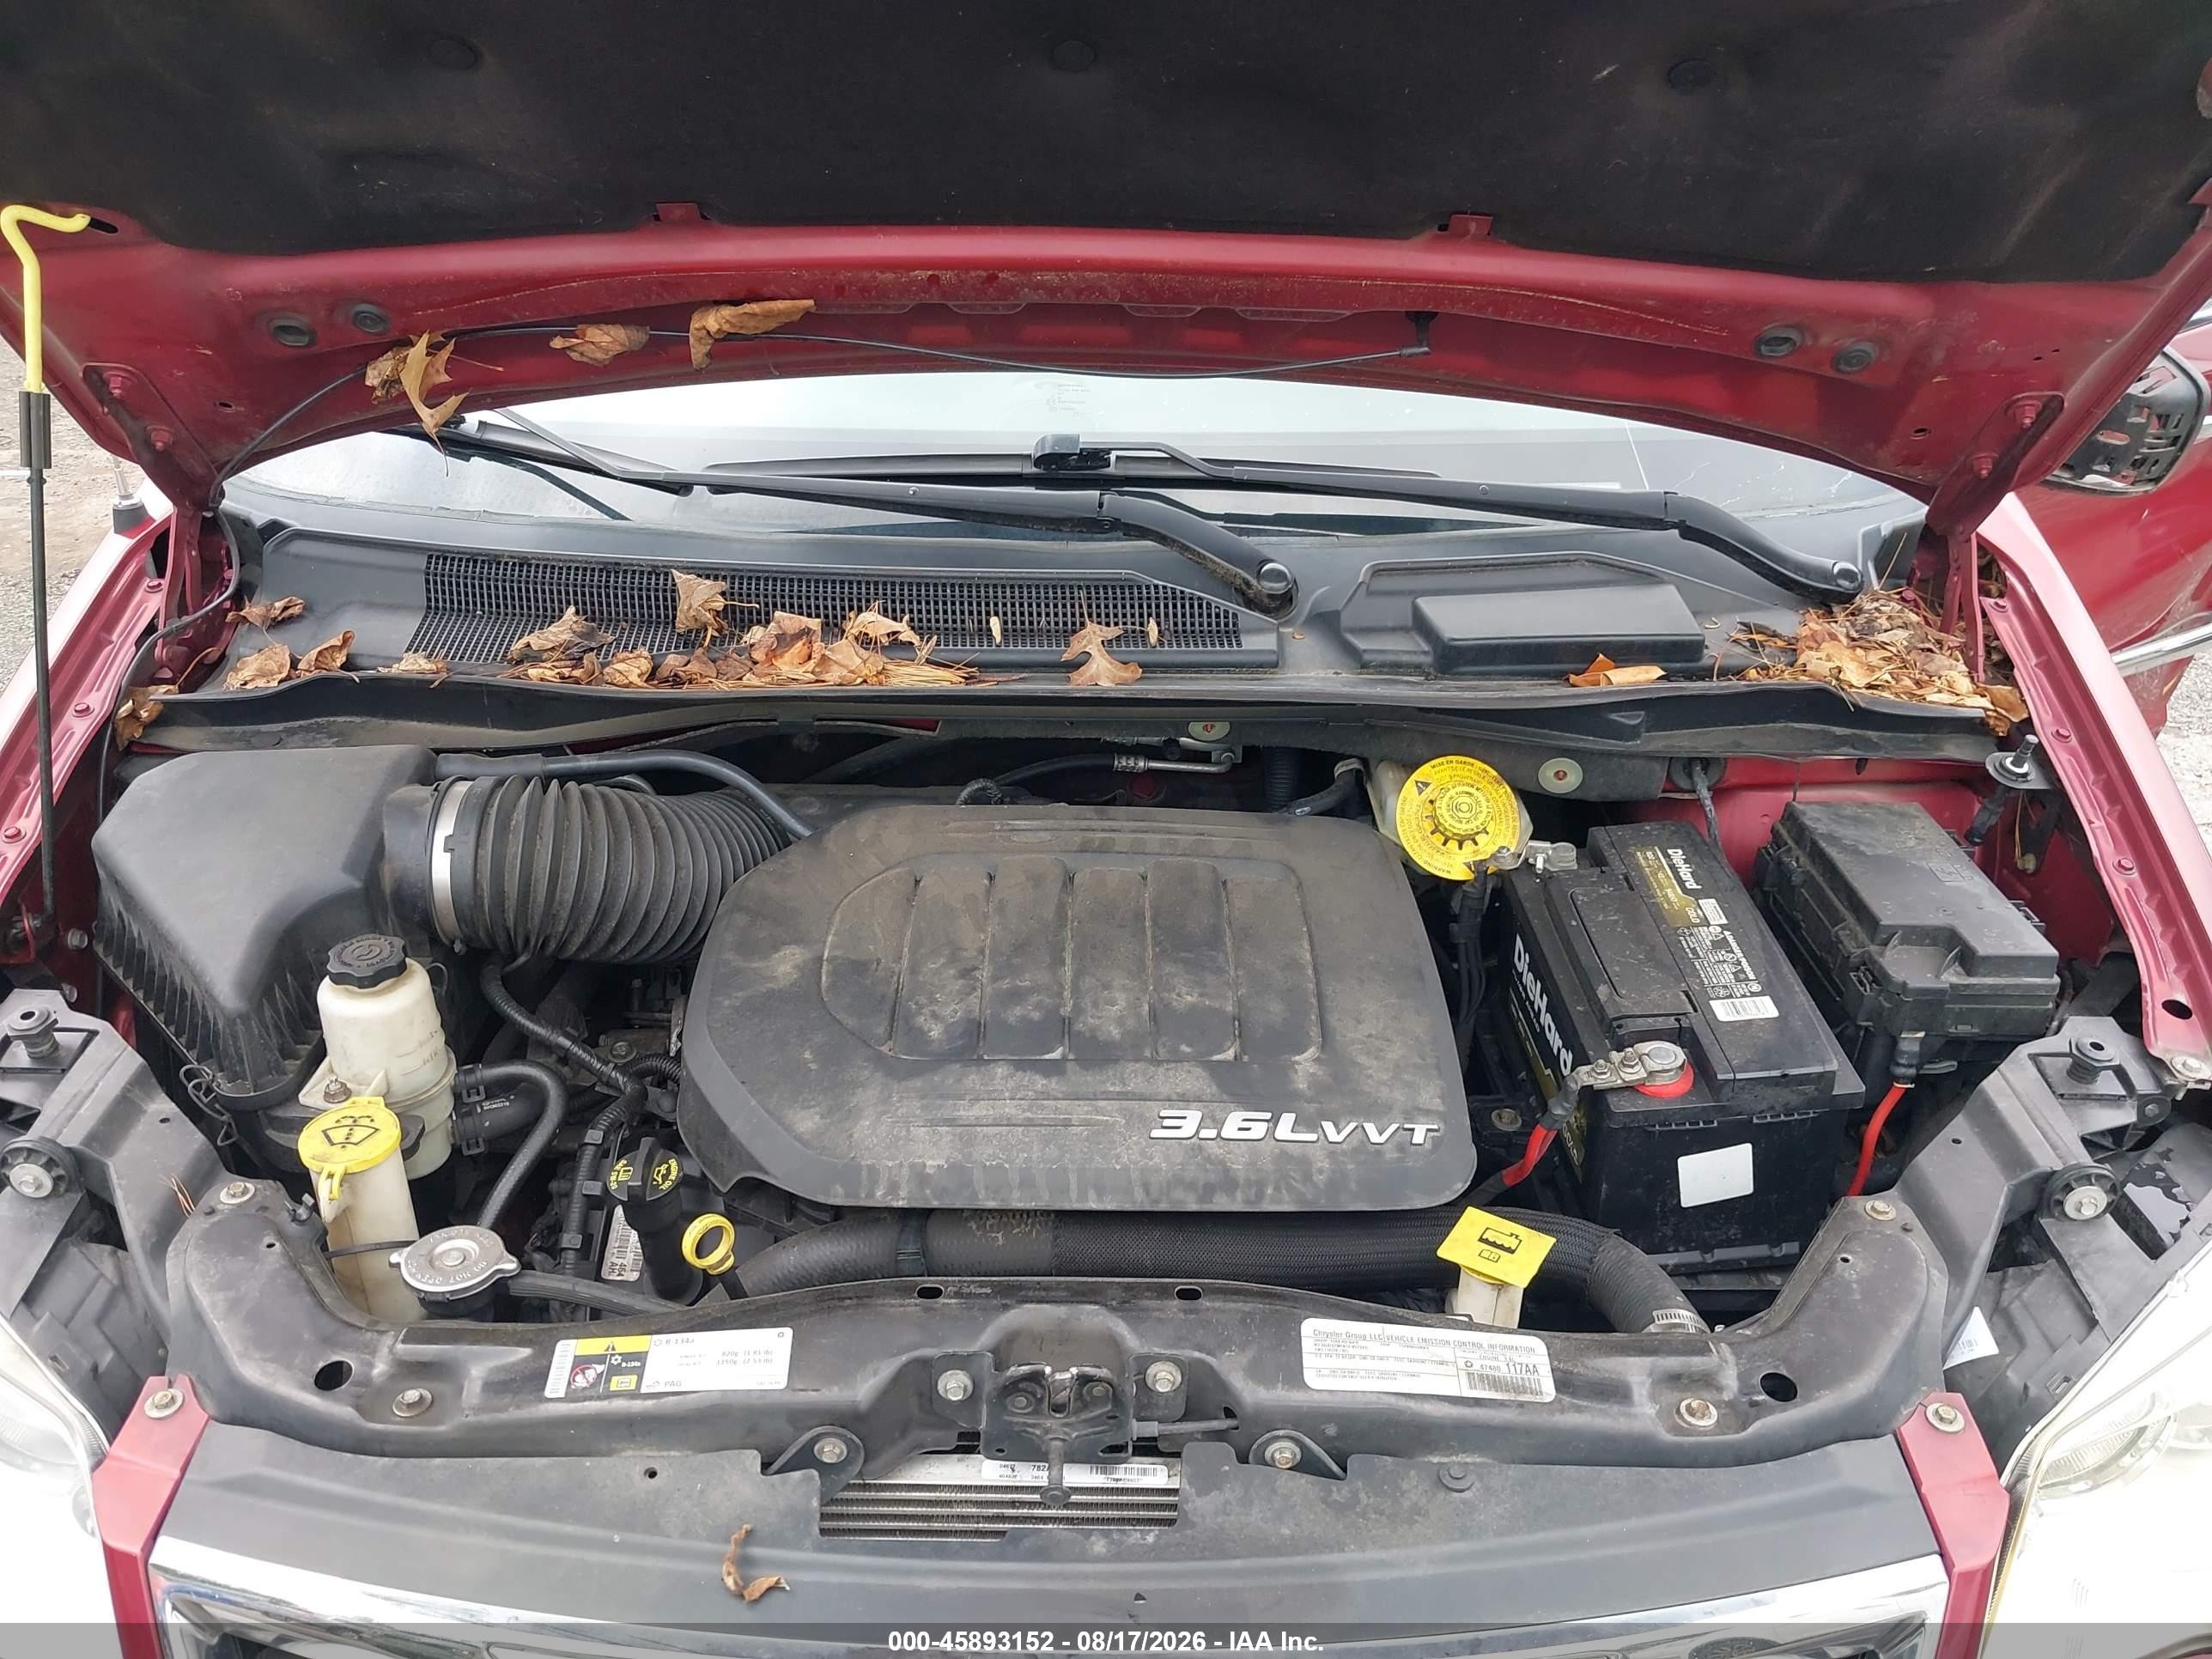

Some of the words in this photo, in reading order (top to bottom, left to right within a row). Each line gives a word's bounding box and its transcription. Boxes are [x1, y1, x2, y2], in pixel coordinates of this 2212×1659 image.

[1668, 848, 1702, 890] DieHard
[1686, 907, 1700, 923] GOLD
[1514, 933, 1573, 1076] DieHard
[1150, 1109, 1319, 1143] 3.6L
[1321, 1121, 1440, 1145] VVT
[613, 1159, 628, 1171] SAE
[668, 1158, 678, 1181] ENGINE
[659, 1180, 672, 1190] OIL
[1313, 1329, 1342, 1340] Chrysler
[1346, 1331, 1367, 1340] Group
[1369, 1332, 1383, 1340] LLC
[1386, 1334, 1414, 1344] VEHICLE
[1417, 1336, 1451, 1346] EMISSION
[1453, 1340, 1485, 1349] CONTROL
[1487, 1343, 1535, 1353] INFORMATION
[1506, 1363, 1540, 1376] 117AA
